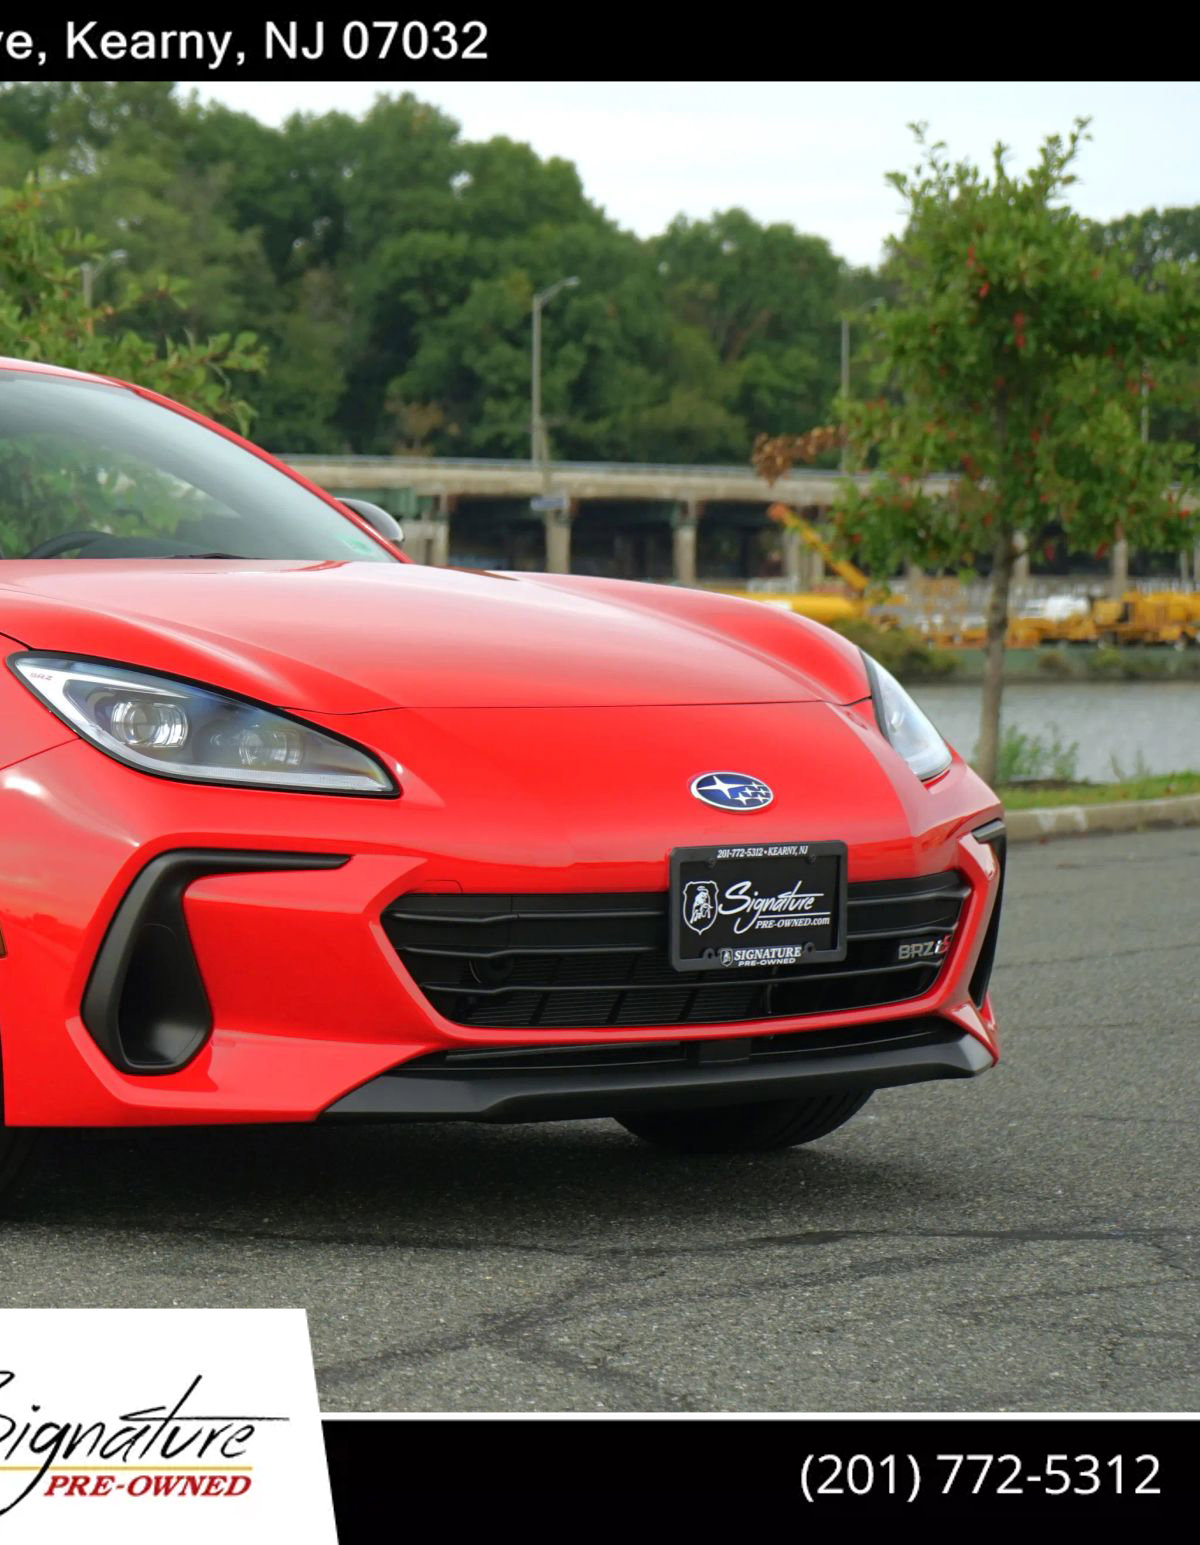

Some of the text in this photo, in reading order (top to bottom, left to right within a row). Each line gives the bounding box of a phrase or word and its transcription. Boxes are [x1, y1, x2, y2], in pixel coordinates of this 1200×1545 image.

[716, 845, 809, 859] 201-772-5312 KEARNY, NJ
[719, 880, 825, 935] Signature
[755, 917, 831, 930] PRE-OWNED.com
[734, 946, 802, 961] SIGNATURE
[898, 940, 935, 960] BRZ
[737, 957, 797, 967] PRE-OWNED
